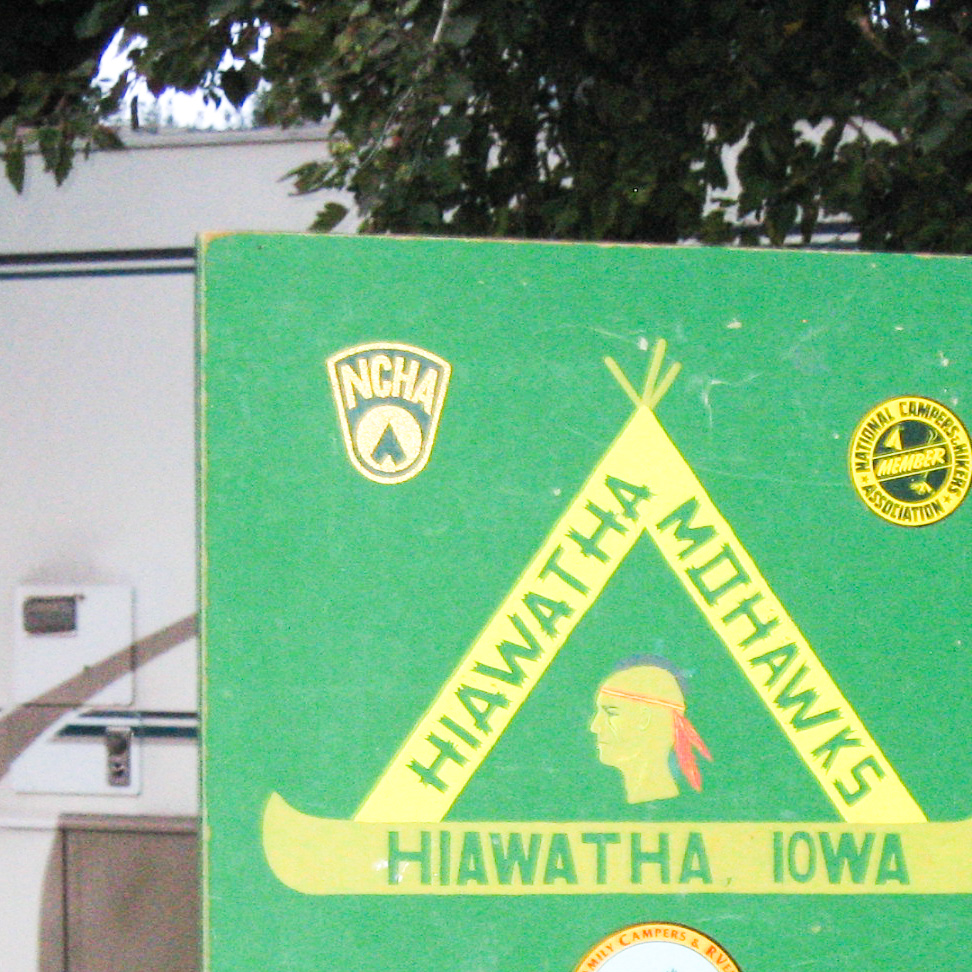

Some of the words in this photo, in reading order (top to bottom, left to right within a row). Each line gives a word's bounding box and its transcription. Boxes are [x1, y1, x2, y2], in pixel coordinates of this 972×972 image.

[340, 354, 439, 416] NCHA
[855, 407, 894, 473] NATIONAL
[899, 401, 959, 440] CAMPERS
[946, 443, 971, 497] HIKERS
[876, 447, 946, 477] MEMBER
[861, 484, 946, 522] ASSOCIATION
[406, 475, 656, 794] HIAWATHA
[656, 496, 885, 807] MOHAWKS
[773, 830, 911, 884] IOWA
[619, 928, 687, 947] CAMPERS
[691, 938, 700, 949] &
